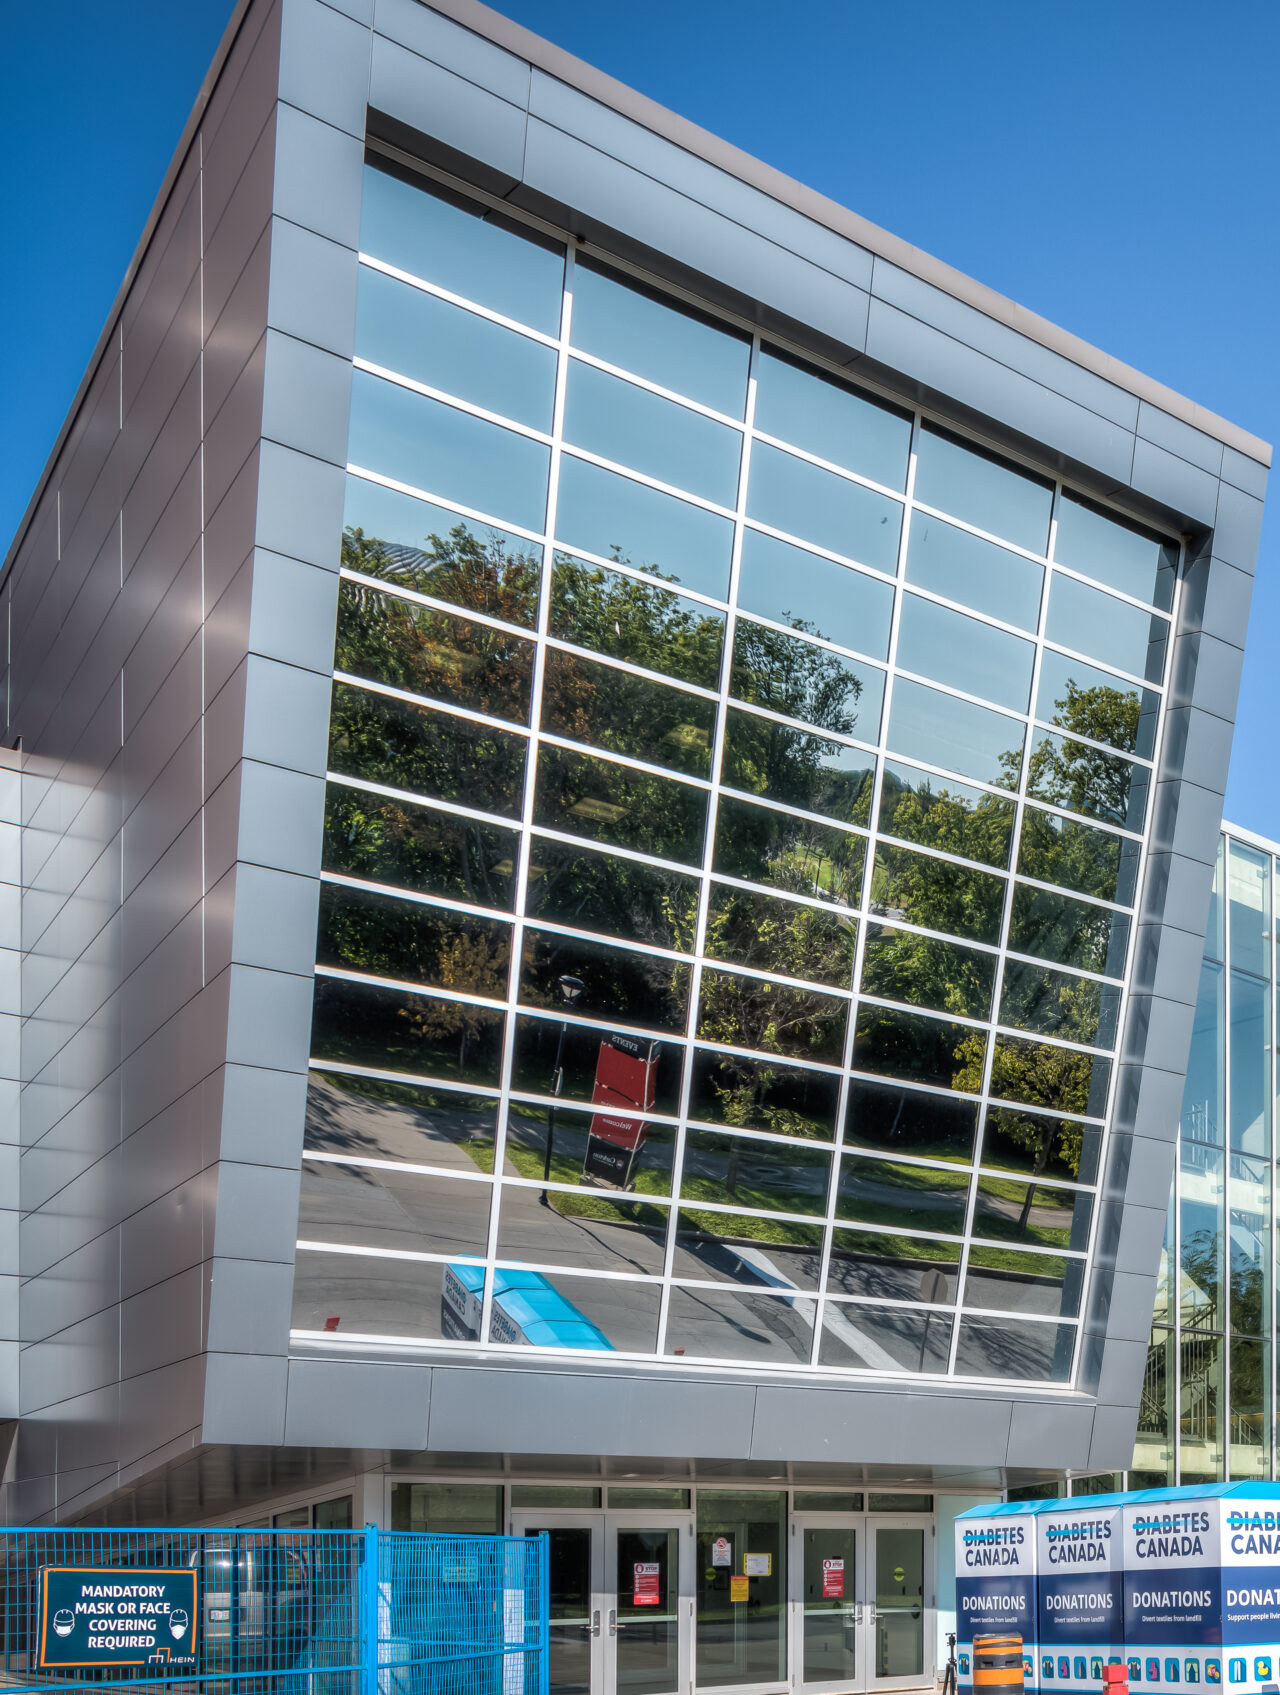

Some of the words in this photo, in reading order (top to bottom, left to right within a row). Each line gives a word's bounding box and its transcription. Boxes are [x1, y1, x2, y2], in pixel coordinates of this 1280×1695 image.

[1048, 1519, 1112, 1543] DIABETES
[1135, 1511, 1210, 1536] DIABETES
[965, 1526, 1025, 1547] DIABETES
[1048, 1541, 1106, 1564] CANADA
[1135, 1535, 1204, 1559] CANADA
[965, 1547, 1019, 1567] CANADA
[81, 1585, 166, 1598] MANDATORY
[1132, 1590, 1212, 1608] DONATIONS
[75, 1602, 114, 1614] MASK
[117, 1602, 136, 1614] OR
[139, 1602, 171, 1614] FACE
[962, 1595, 1026, 1611] DONATIONS
[1046, 1593, 1113, 1610] DONATIONS
[89, 1619, 157, 1631] COVERING
[1141, 1615, 1156, 1623] Divert
[1173, 1614, 1185, 1622] from
[1185, 1614, 1202, 1622] landfill
[1227, 1613, 1249, 1623] Support
[1250, 1612, 1269, 1622] people
[88, 1635, 156, 1649] REQUIRED
